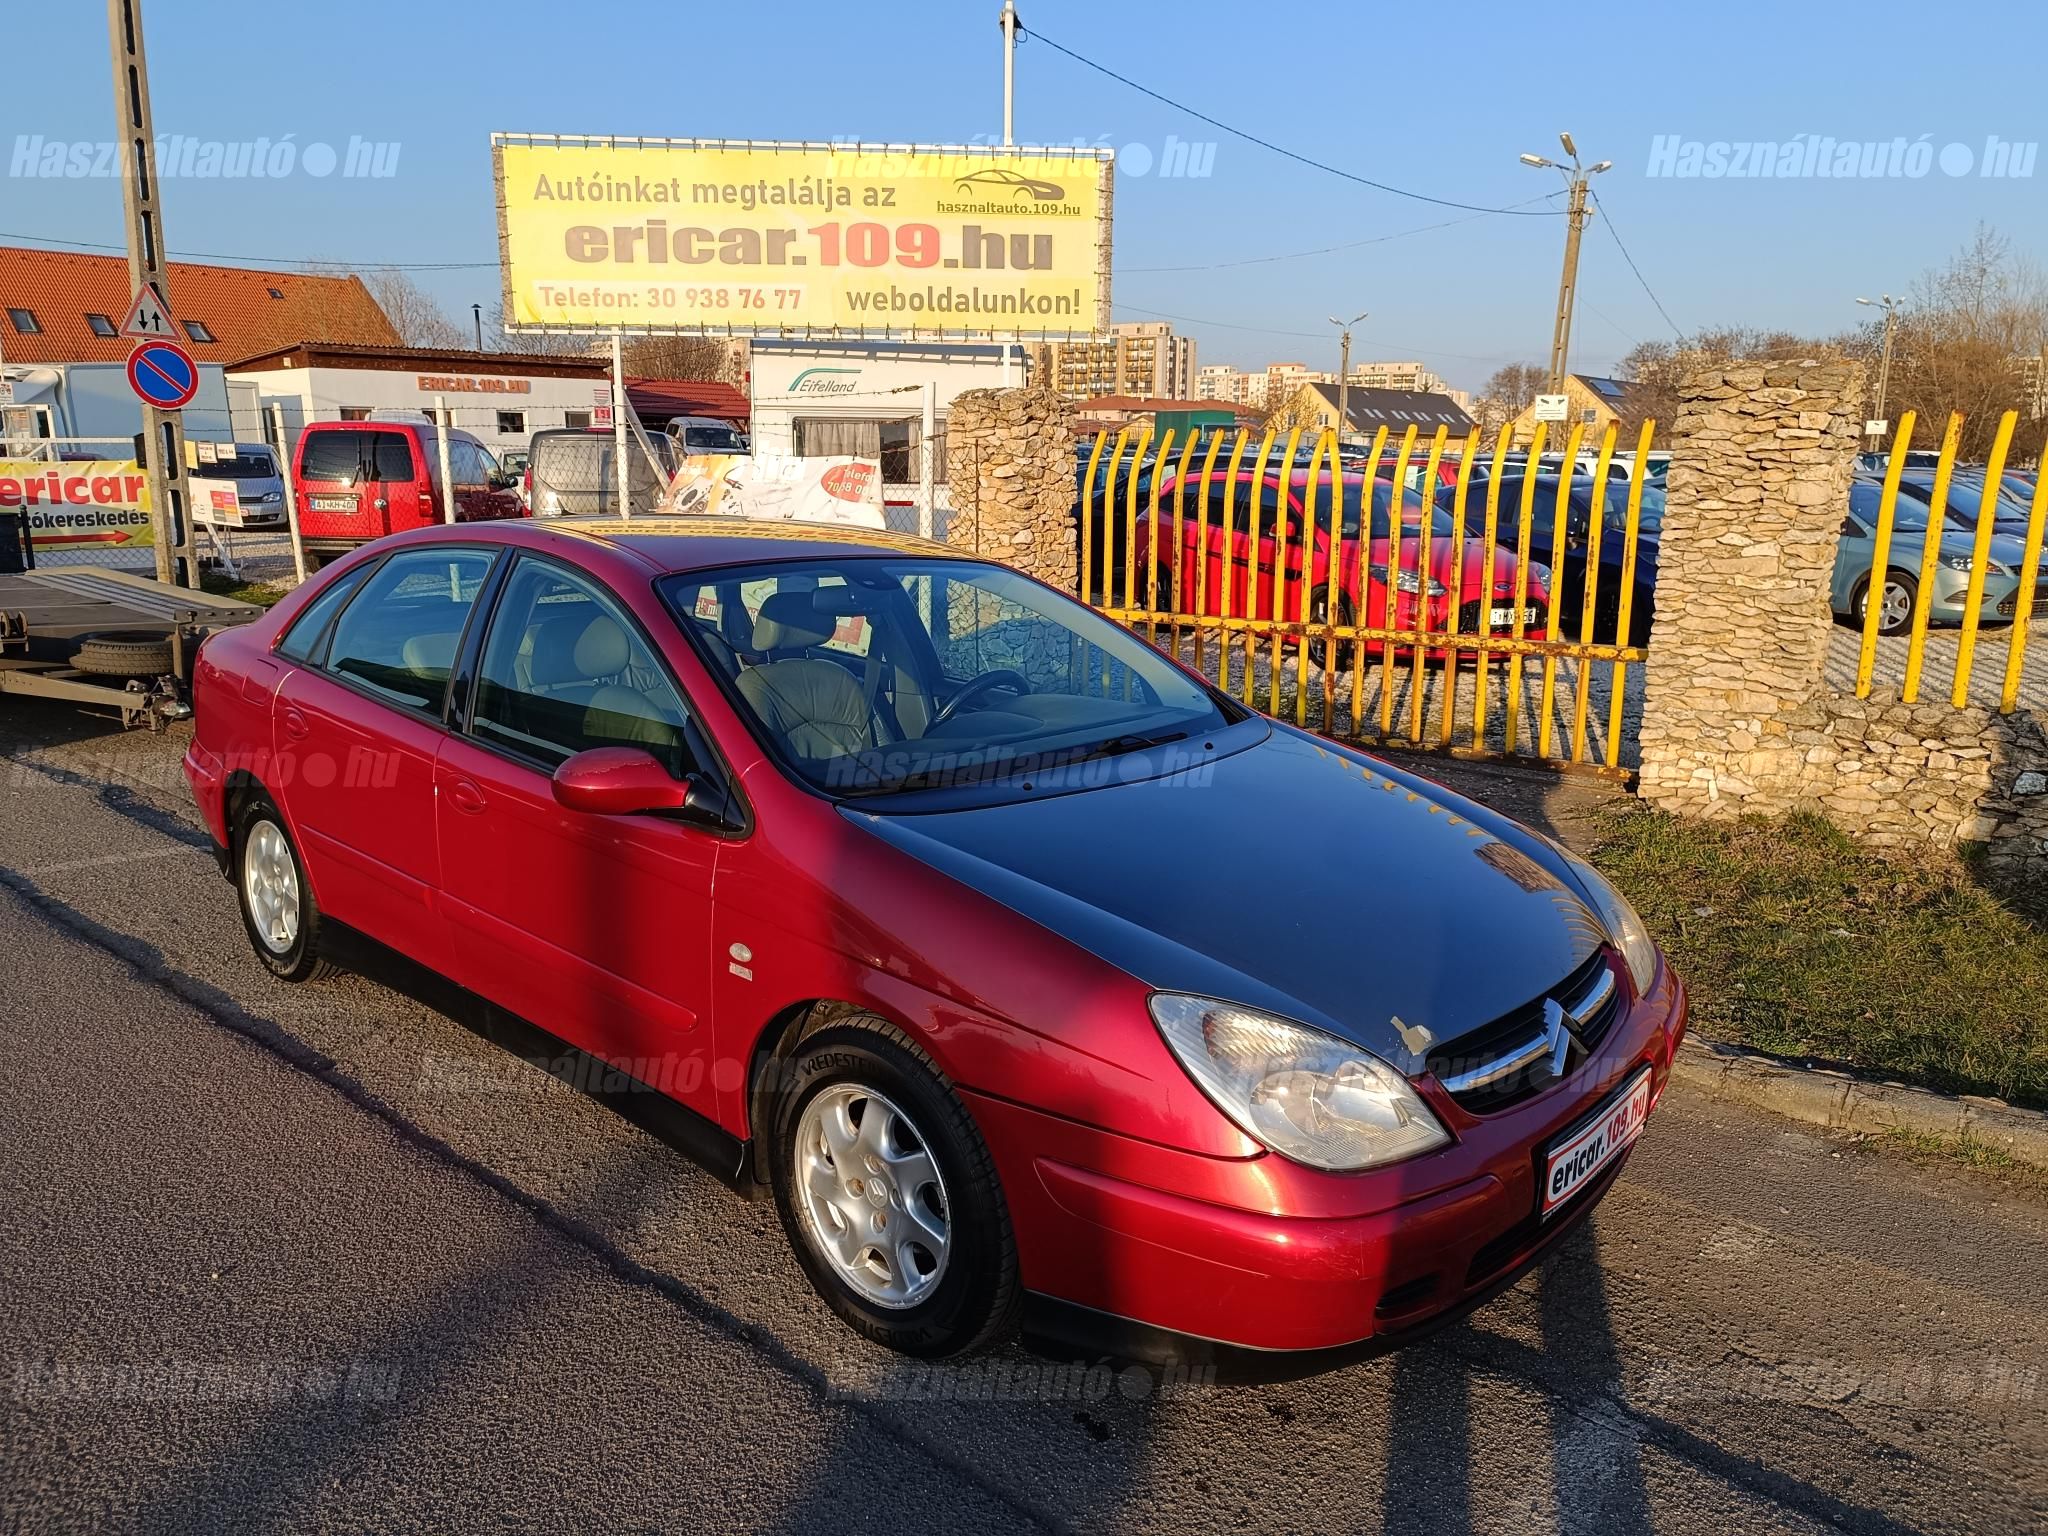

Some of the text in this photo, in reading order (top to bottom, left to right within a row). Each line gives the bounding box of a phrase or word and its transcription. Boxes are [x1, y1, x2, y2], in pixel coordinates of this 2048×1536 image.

[533, 171, 896, 213] Autóinkat megtalálja az
[937, 200, 1081, 216] hasznaltauto.109.hu
[564, 219, 1053, 271] ericar.109.hu
[538, 286, 801, 310] Telefon: 30 938 76 77
[846, 285, 1080, 315] weboldalunkon!
[799, 379, 857, 392] Eifelland
